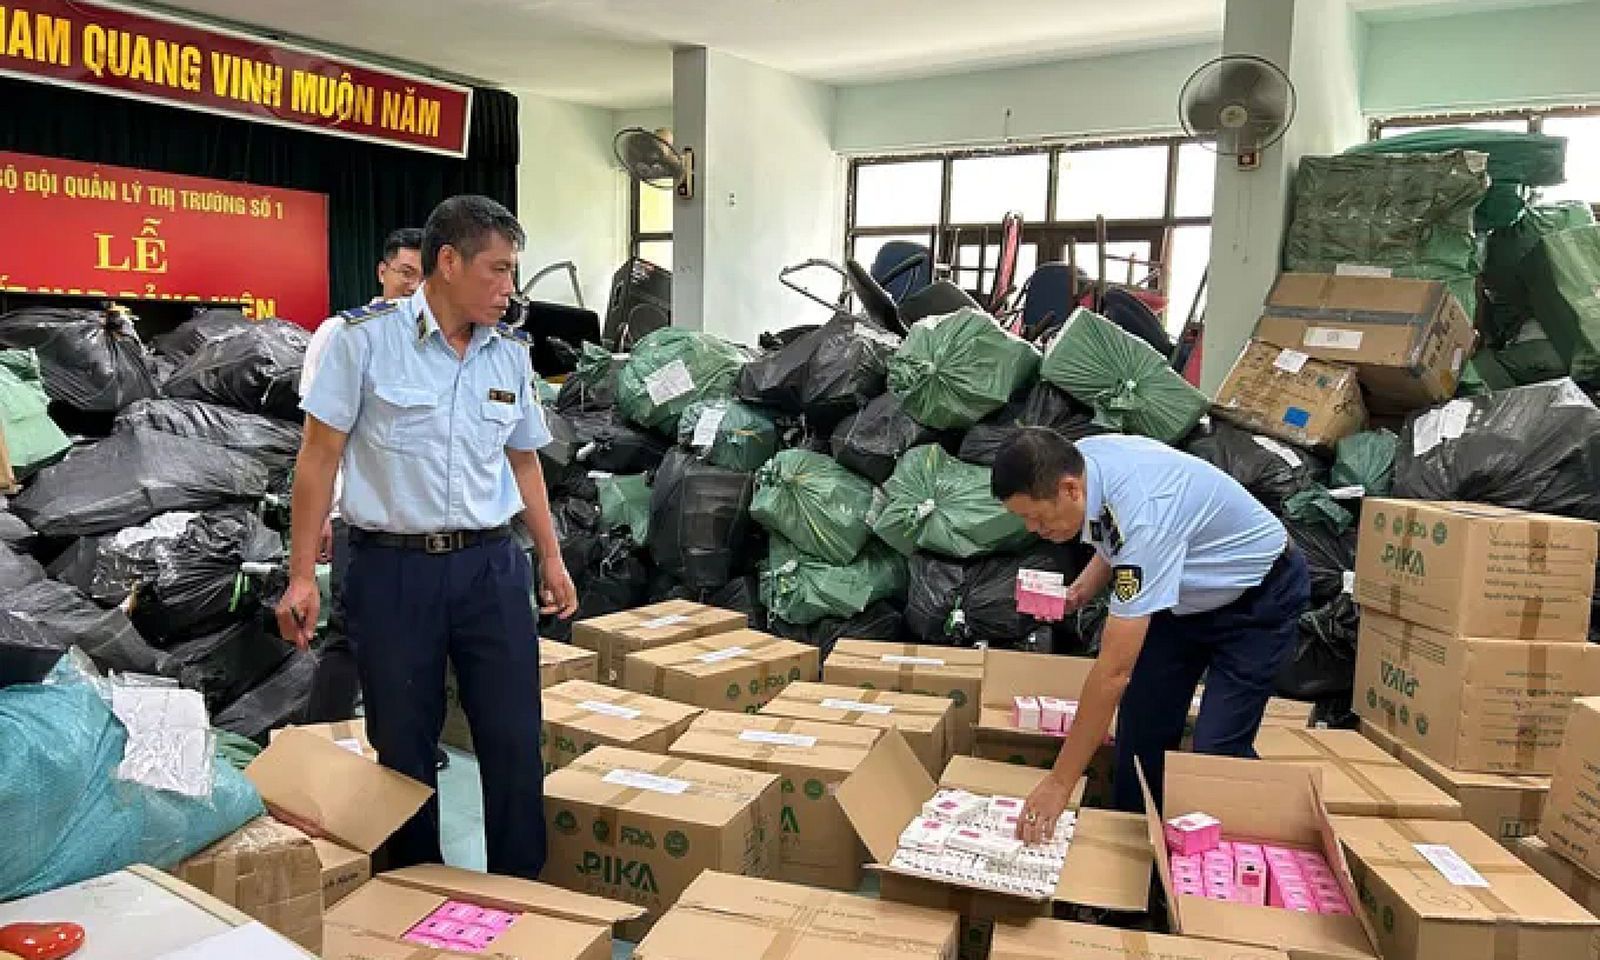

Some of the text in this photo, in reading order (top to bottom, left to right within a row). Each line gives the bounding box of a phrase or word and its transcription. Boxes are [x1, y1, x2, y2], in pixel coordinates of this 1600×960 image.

[82, 23, 201, 92] QUANG
[211, 51, 284, 107] VINH
[380, 87, 441, 137] NĂM
[24, 169, 58, 198] ĐỘI
[64, 172, 117, 201] QUẢN
[122, 180, 143, 203] LÝ
[148, 185, 175, 212] THỊ
[179, 190, 246, 216] TRƯỜNG
[249, 194, 271, 219] SỐ
[274, 202, 284, 220] 1
[93, 217, 168, 274] LỄ
[1380, 542, 1425, 577] PIKA
[575, 850, 660, 895] PIKA
